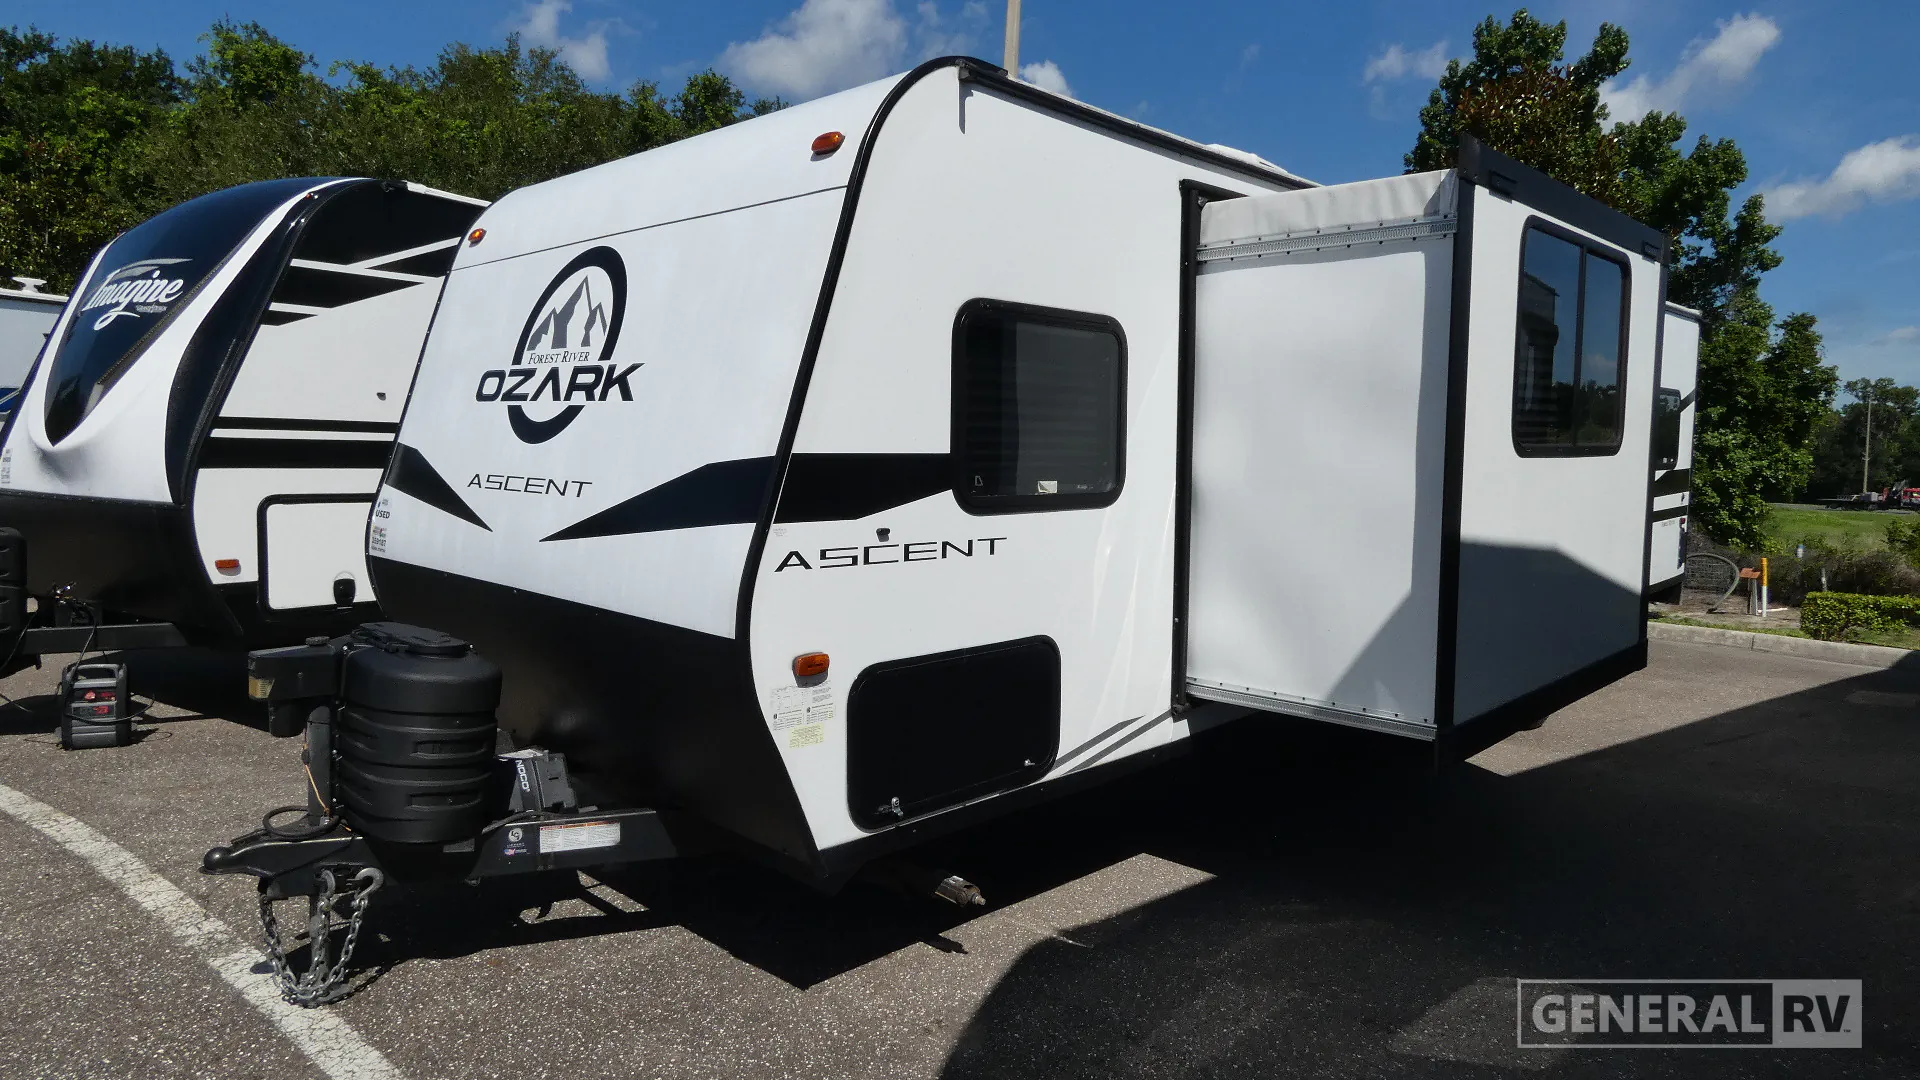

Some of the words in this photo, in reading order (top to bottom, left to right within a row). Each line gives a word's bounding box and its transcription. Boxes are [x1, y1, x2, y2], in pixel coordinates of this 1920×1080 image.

[81, 268, 184, 331] Imagine
[528, 352, 561, 365] FOREST
[561, 350, 590, 363] RIVER
[475, 362, 646, 402] OZARK
[467, 473, 593, 498] ASCENT
[375, 509, 391, 519] USED
[774, 537, 1008, 573] ASCENT
[515, 759, 530, 790] NOCO
